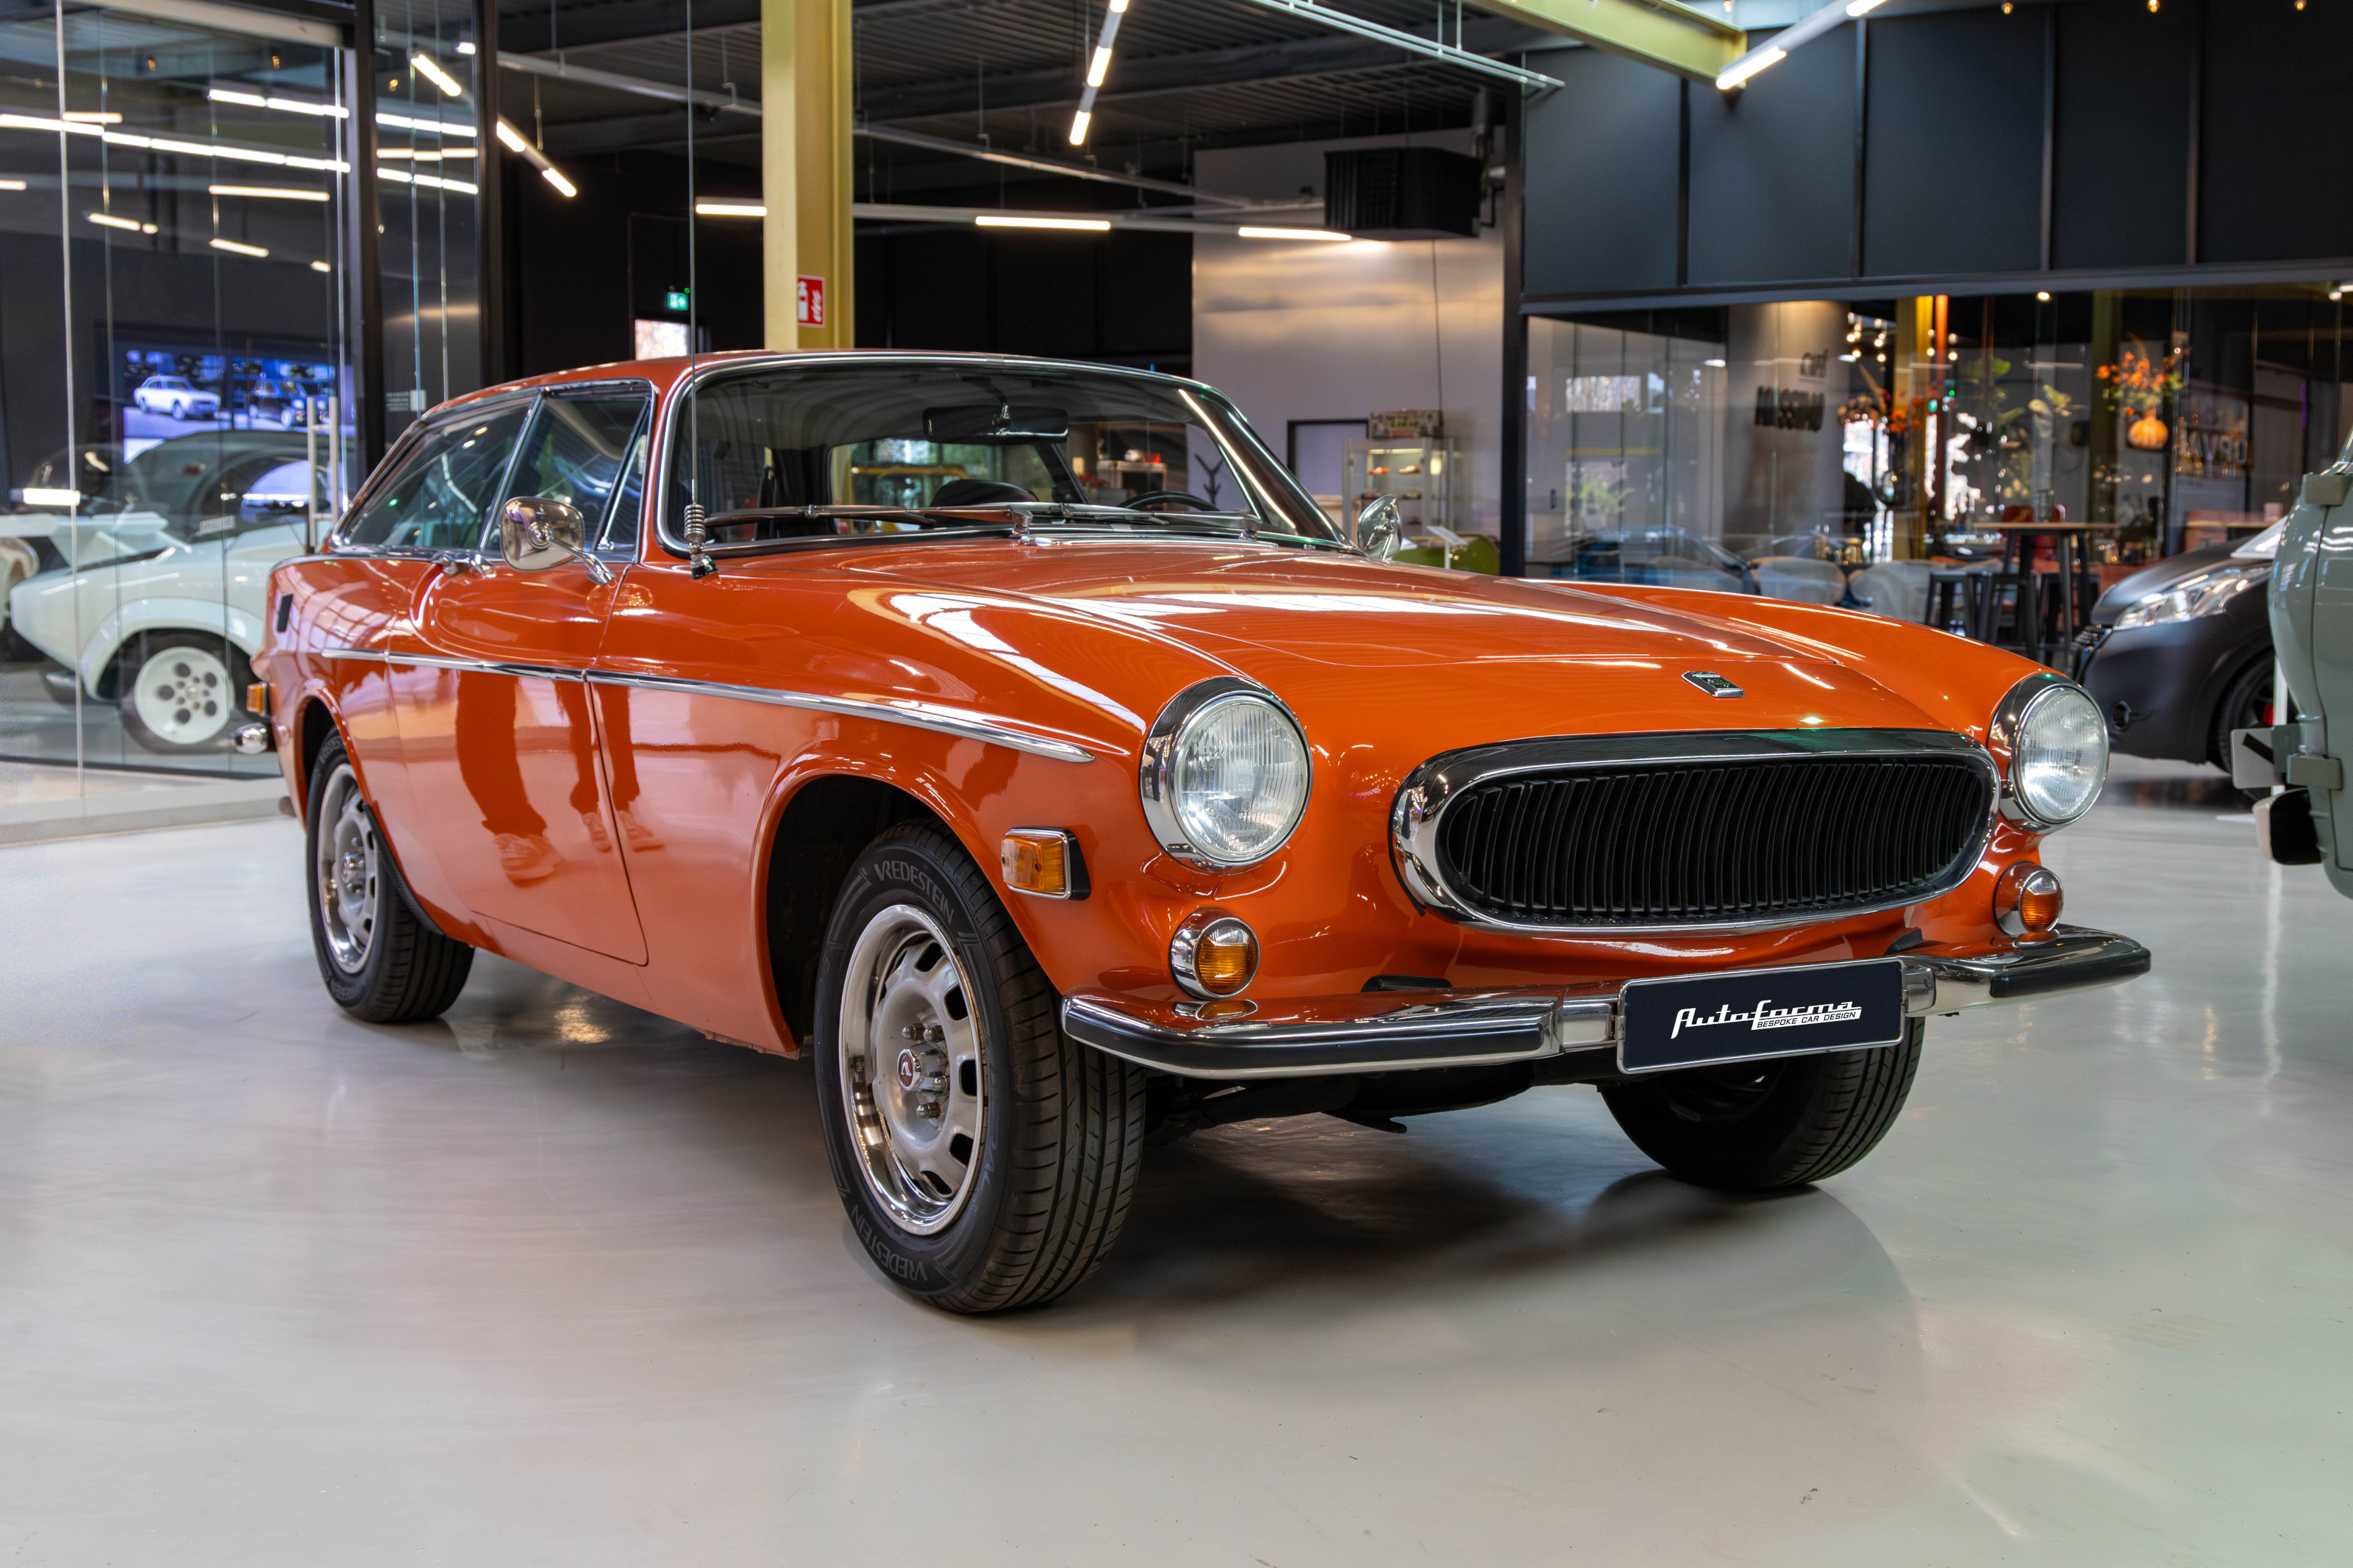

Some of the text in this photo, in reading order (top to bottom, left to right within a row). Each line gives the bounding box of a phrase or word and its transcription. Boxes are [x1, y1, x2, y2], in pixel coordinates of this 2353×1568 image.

[874, 860, 954, 925] VREDESTEIN
[1671, 1000, 1862, 1039] Autoforma
[1757, 1011, 1856, 1028] BESPOKE CAR DESIGN
[851, 1204, 929, 1281] VREDESTEIN
